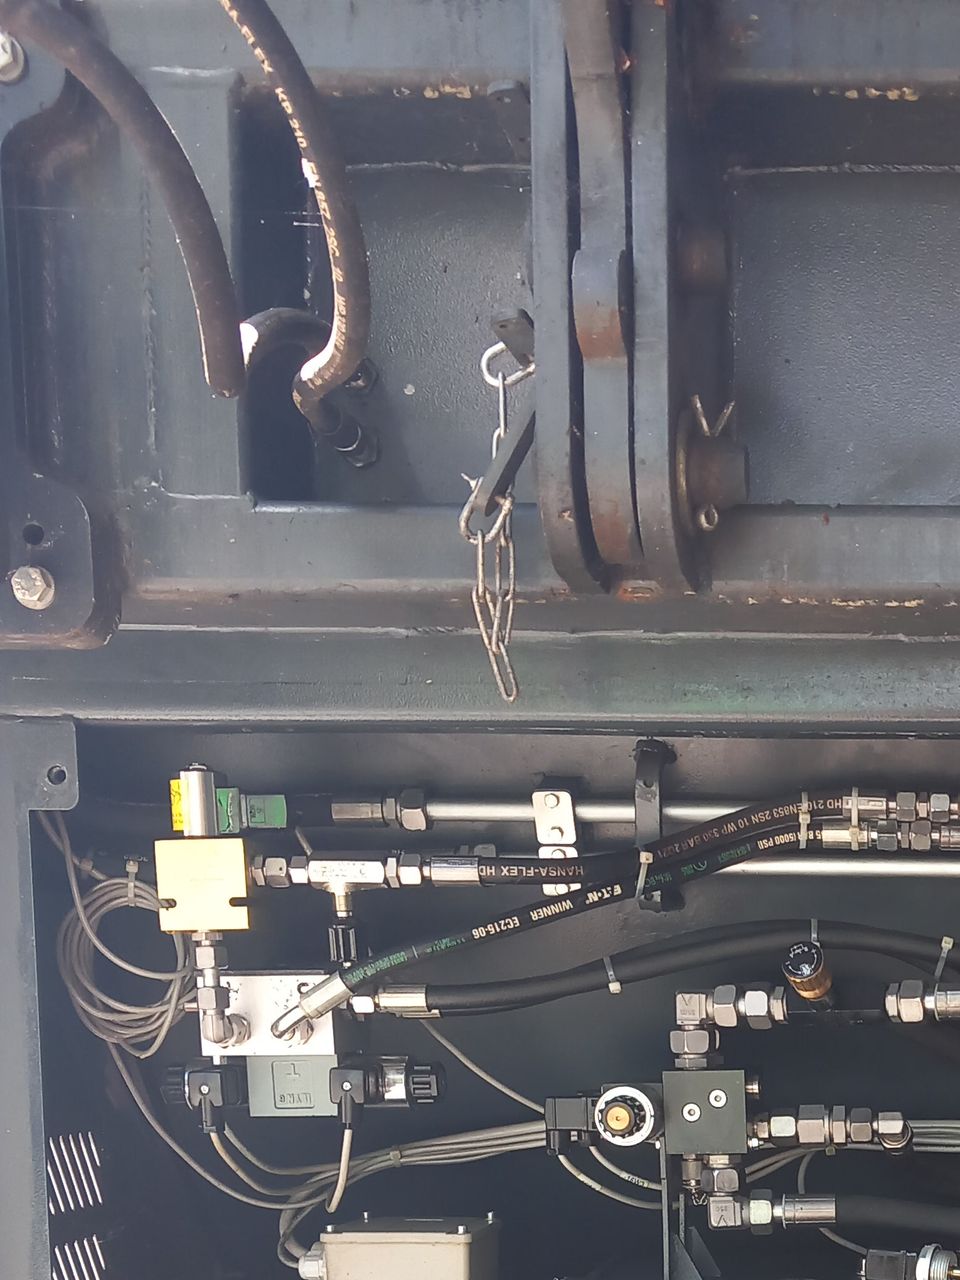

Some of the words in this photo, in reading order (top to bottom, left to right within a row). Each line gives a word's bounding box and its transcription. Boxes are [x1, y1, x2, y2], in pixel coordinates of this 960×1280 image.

[751, 809, 773, 825] 2SN
[772, 802, 803, 819] EN853
[739, 817, 750, 830] 10
[478, 864, 496, 878] HD
[500, 865, 585, 878] HANSA-FLEX
[529, 899, 574, 922] WINNER
[471, 915, 521, 940] EC215-06
